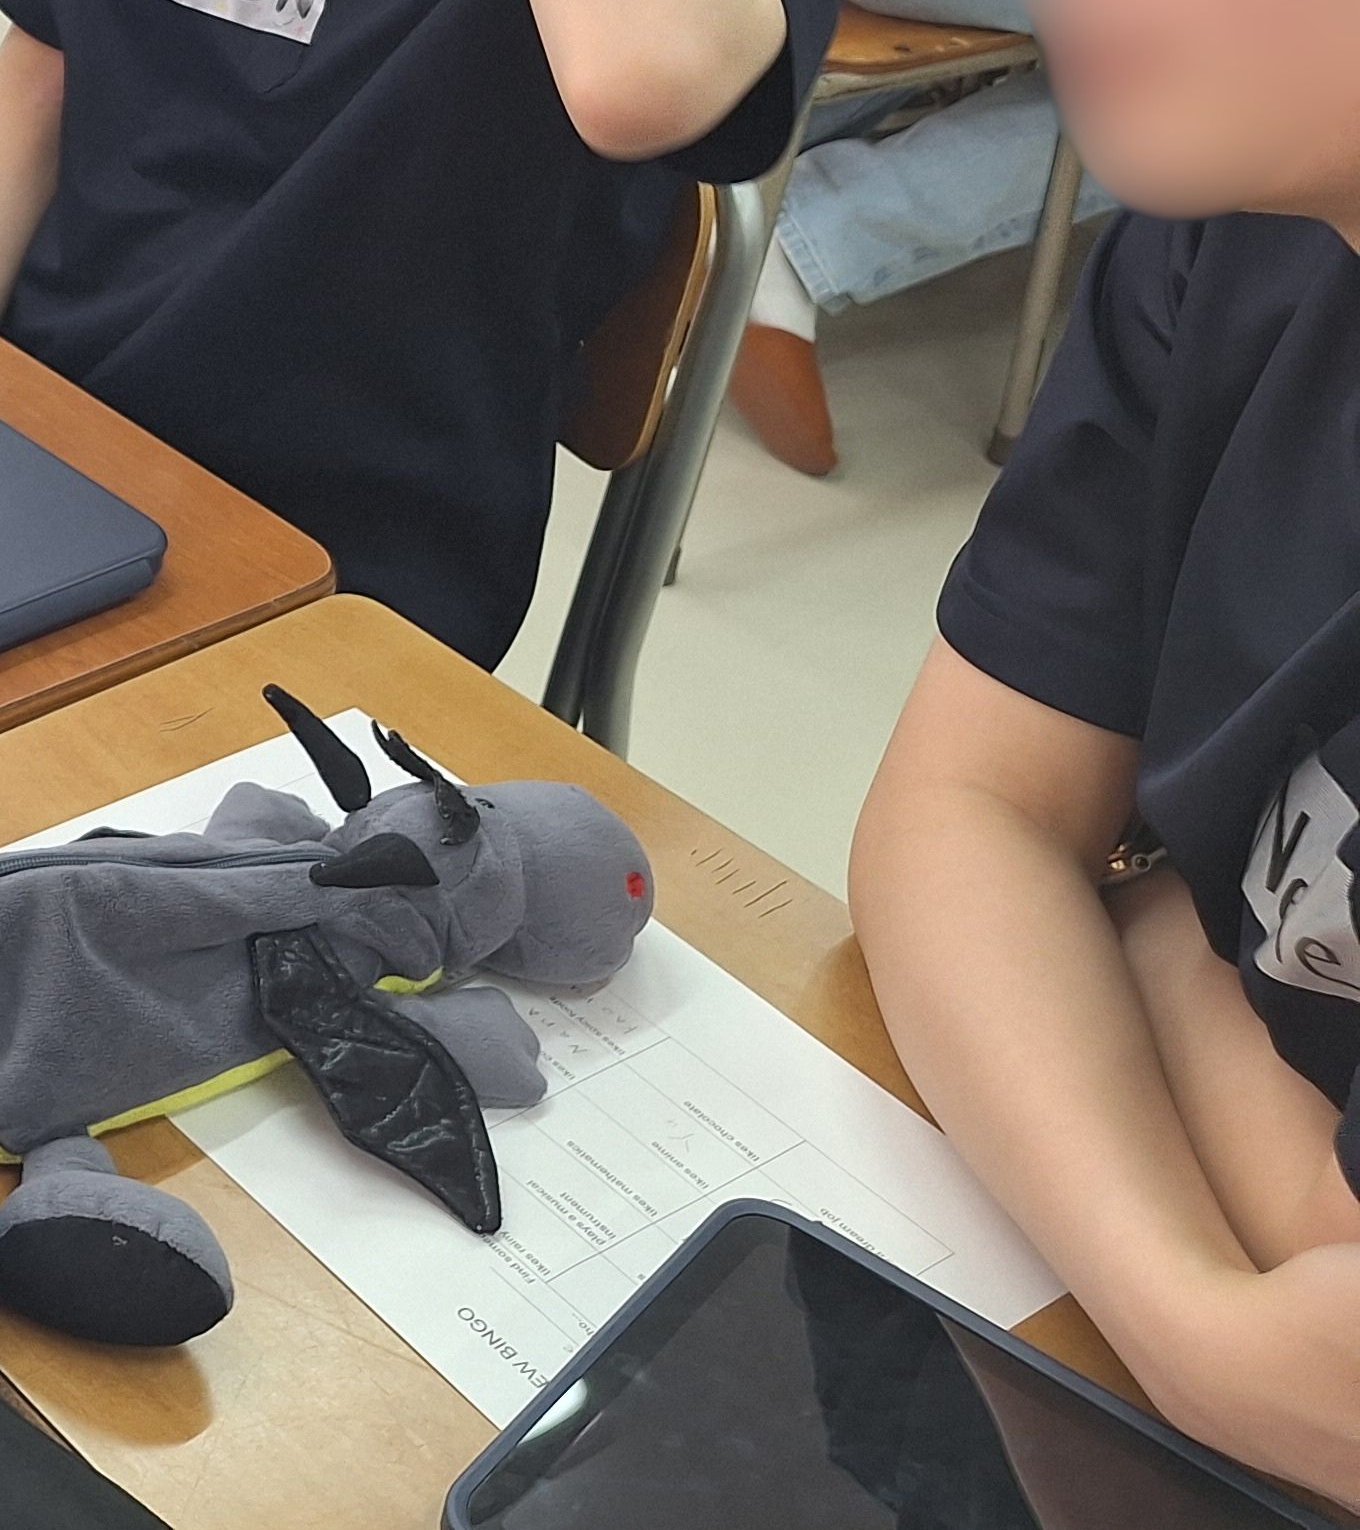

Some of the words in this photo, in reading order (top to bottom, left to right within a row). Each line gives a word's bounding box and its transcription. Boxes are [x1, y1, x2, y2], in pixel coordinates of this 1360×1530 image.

[600, 1035, 626, 1056] likes
[682, 1100, 736, 1141] chocolate
[651, 1140, 685, 1169] anime
[733, 1139, 761, 1163] likes
[566, 1139, 633, 1195] mathematics
[683, 1167, 711, 1191] likes
[526, 1179, 569, 1215] musical
[632, 1193, 659, 1218] likes
[559, 1191, 617, 1240] instrument
[818, 1206, 840, 1228] job
[499, 1231, 527, 1256] rainy
[576, 1220, 608, 1247] plays
[480, 1233, 513, 1264] some
[509, 1262, 536, 1285] Find
[525, 1252, 552, 1277] likes
[457, 1307, 518, 1360] BINGO
